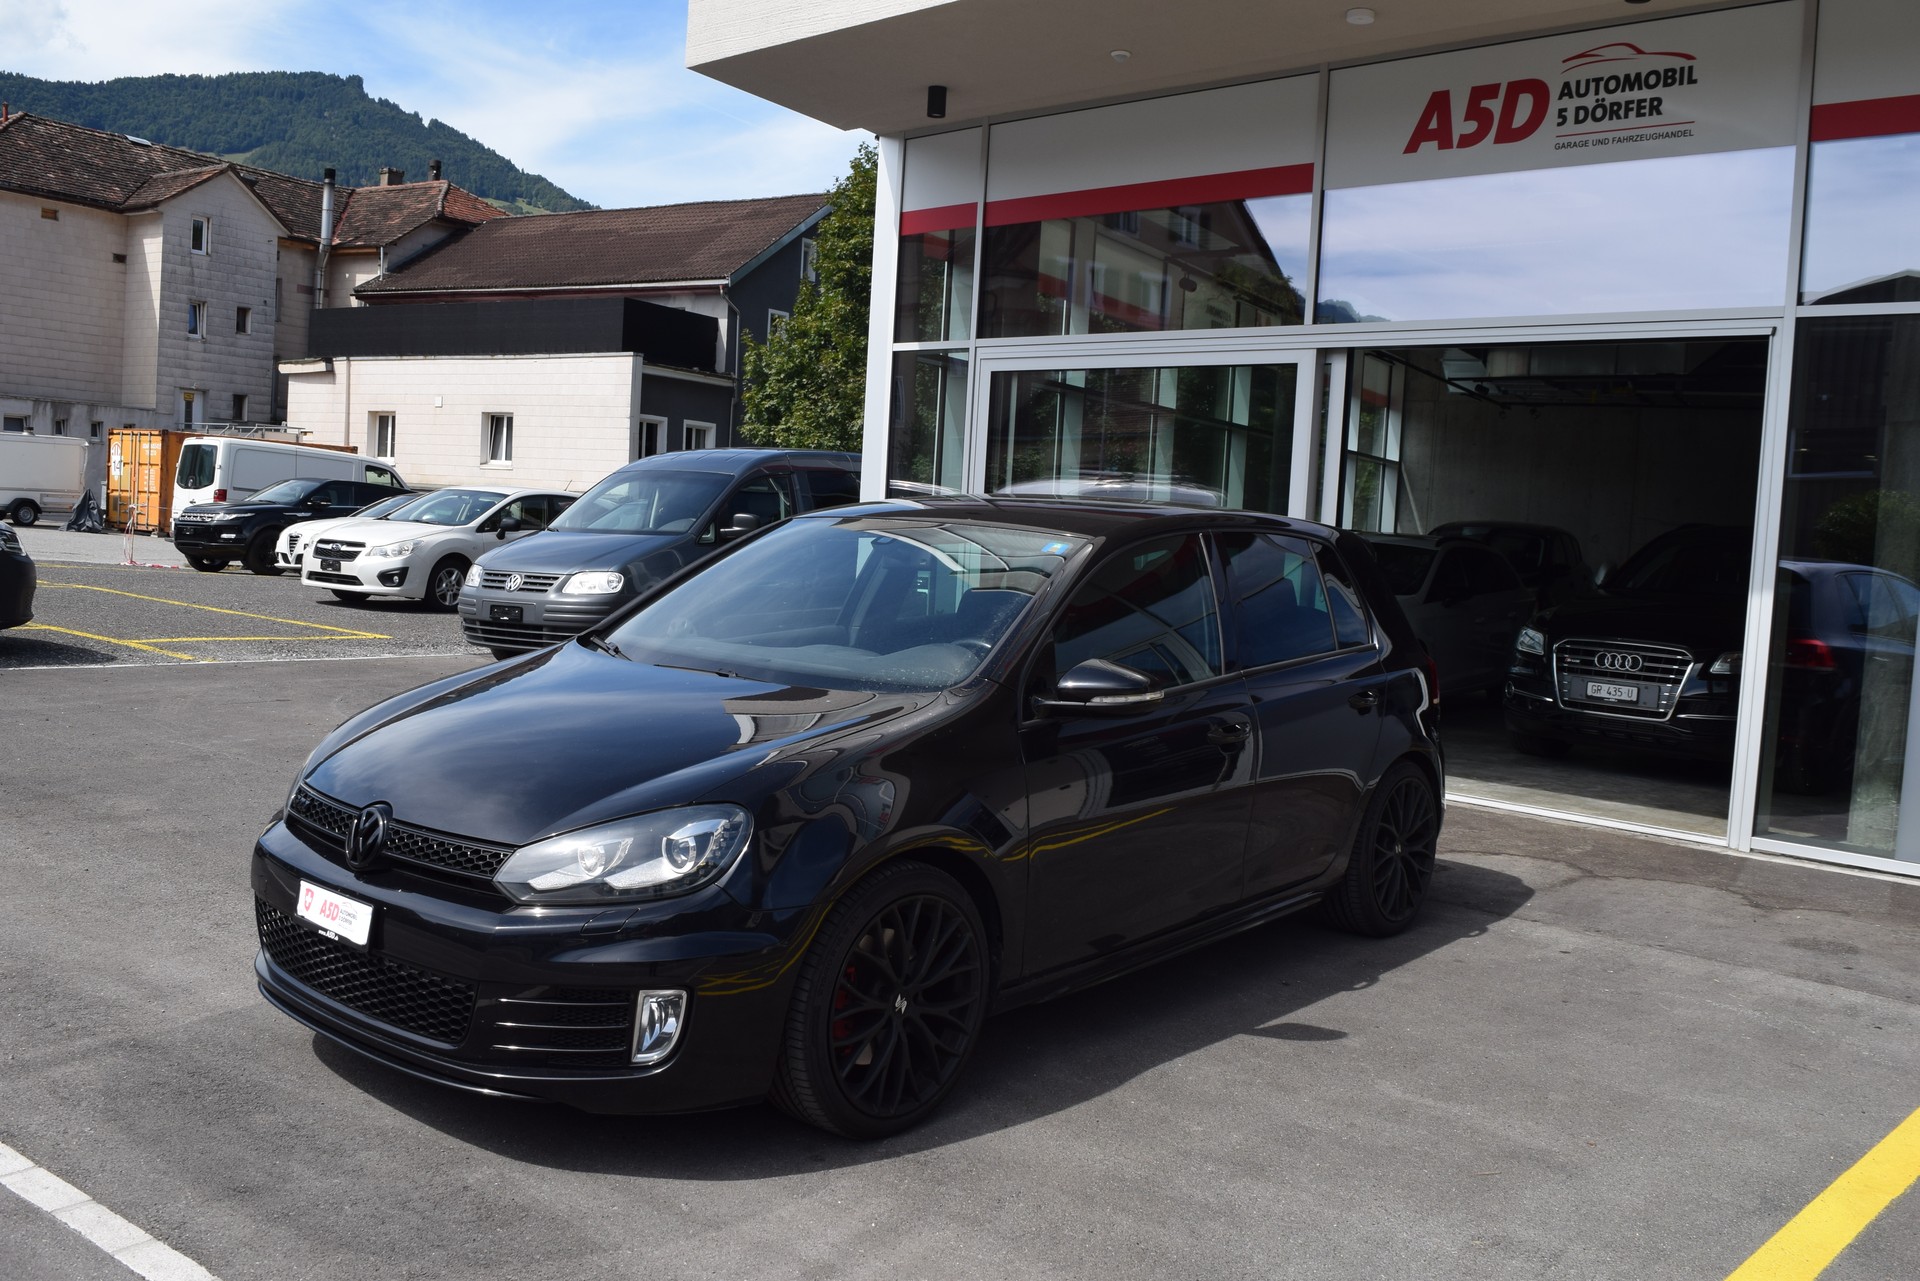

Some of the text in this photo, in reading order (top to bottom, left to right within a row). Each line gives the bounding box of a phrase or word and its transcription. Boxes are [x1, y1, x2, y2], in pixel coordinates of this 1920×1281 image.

[1557, 65, 1698, 101] AUTOMOBIL
[1402, 78, 1550, 154] A5D
[1556, 96, 1663, 127] 5 DÖRFER
[1554, 129, 1695, 151] GARAGE UND FAHRZEUGHANDEL
[1591, 684, 1603, 695] GR
[1606, 686, 1623, 697] 435
[319, 900, 340, 922] A5D
